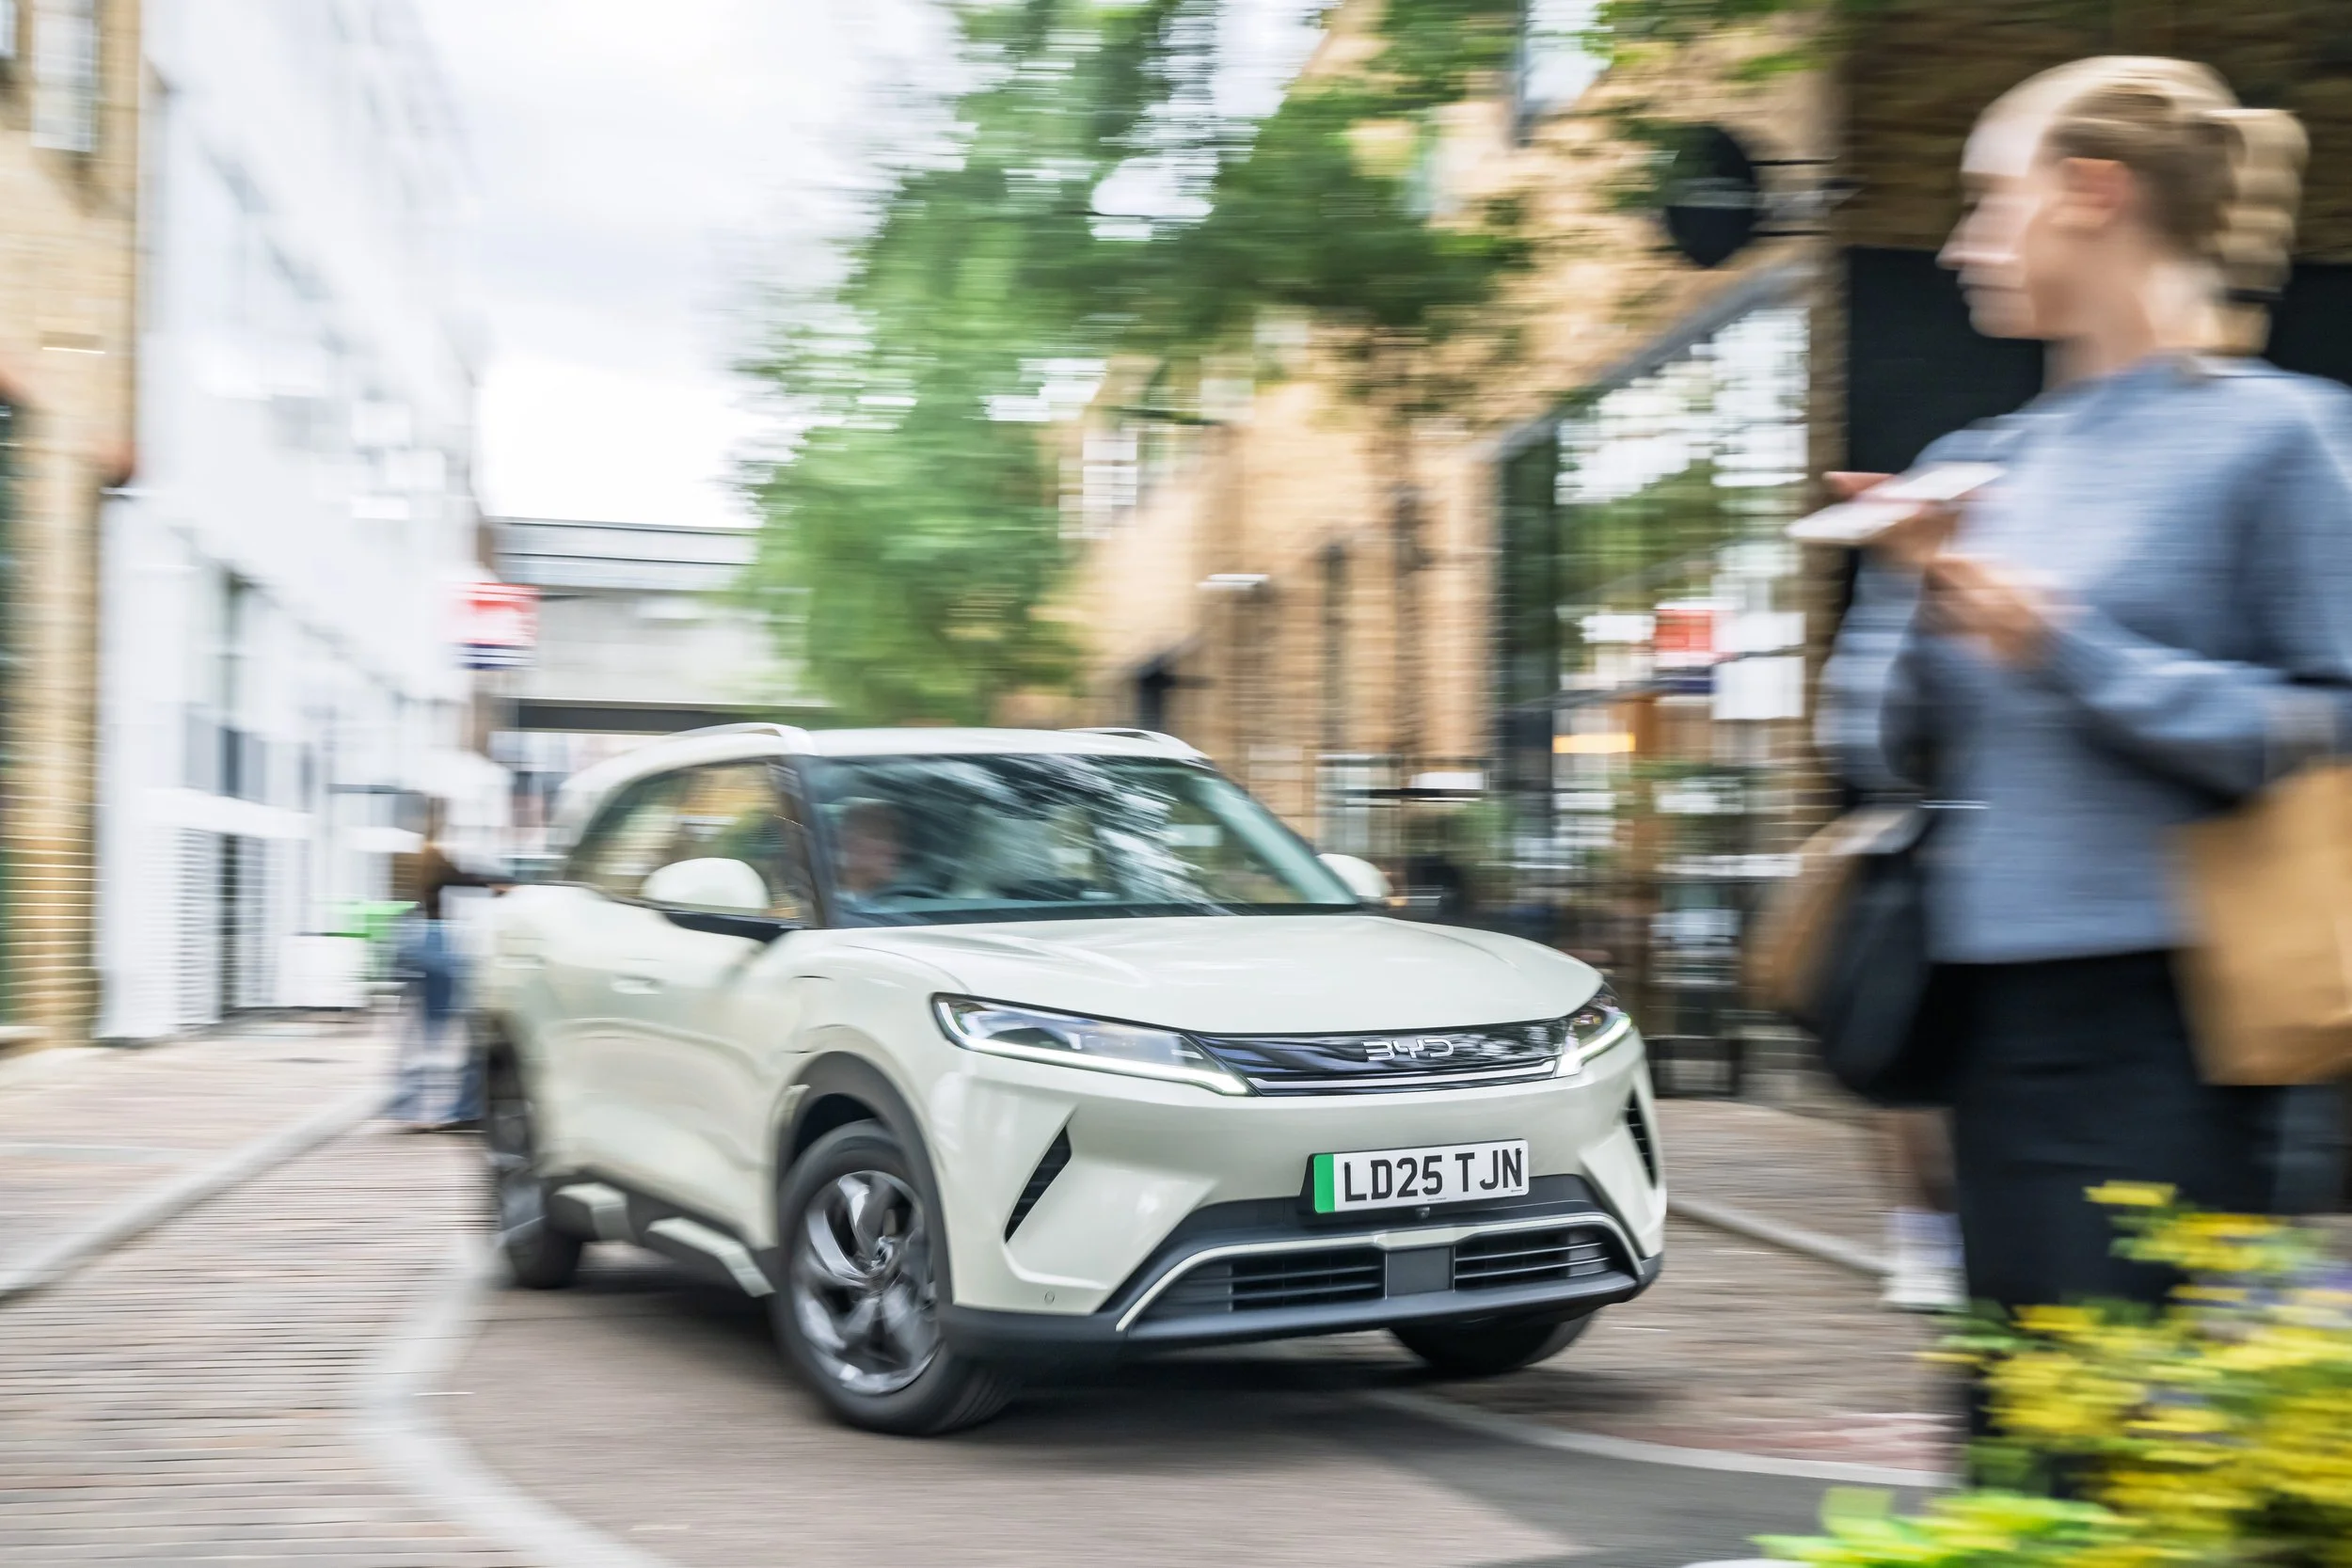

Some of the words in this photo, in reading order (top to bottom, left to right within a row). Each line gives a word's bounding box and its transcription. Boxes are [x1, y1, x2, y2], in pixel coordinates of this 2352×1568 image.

[1362, 1038, 1454, 1061] BYD
[1343, 1154, 1443, 1202] LD25
[1454, 1147, 1523, 1193] TJN
